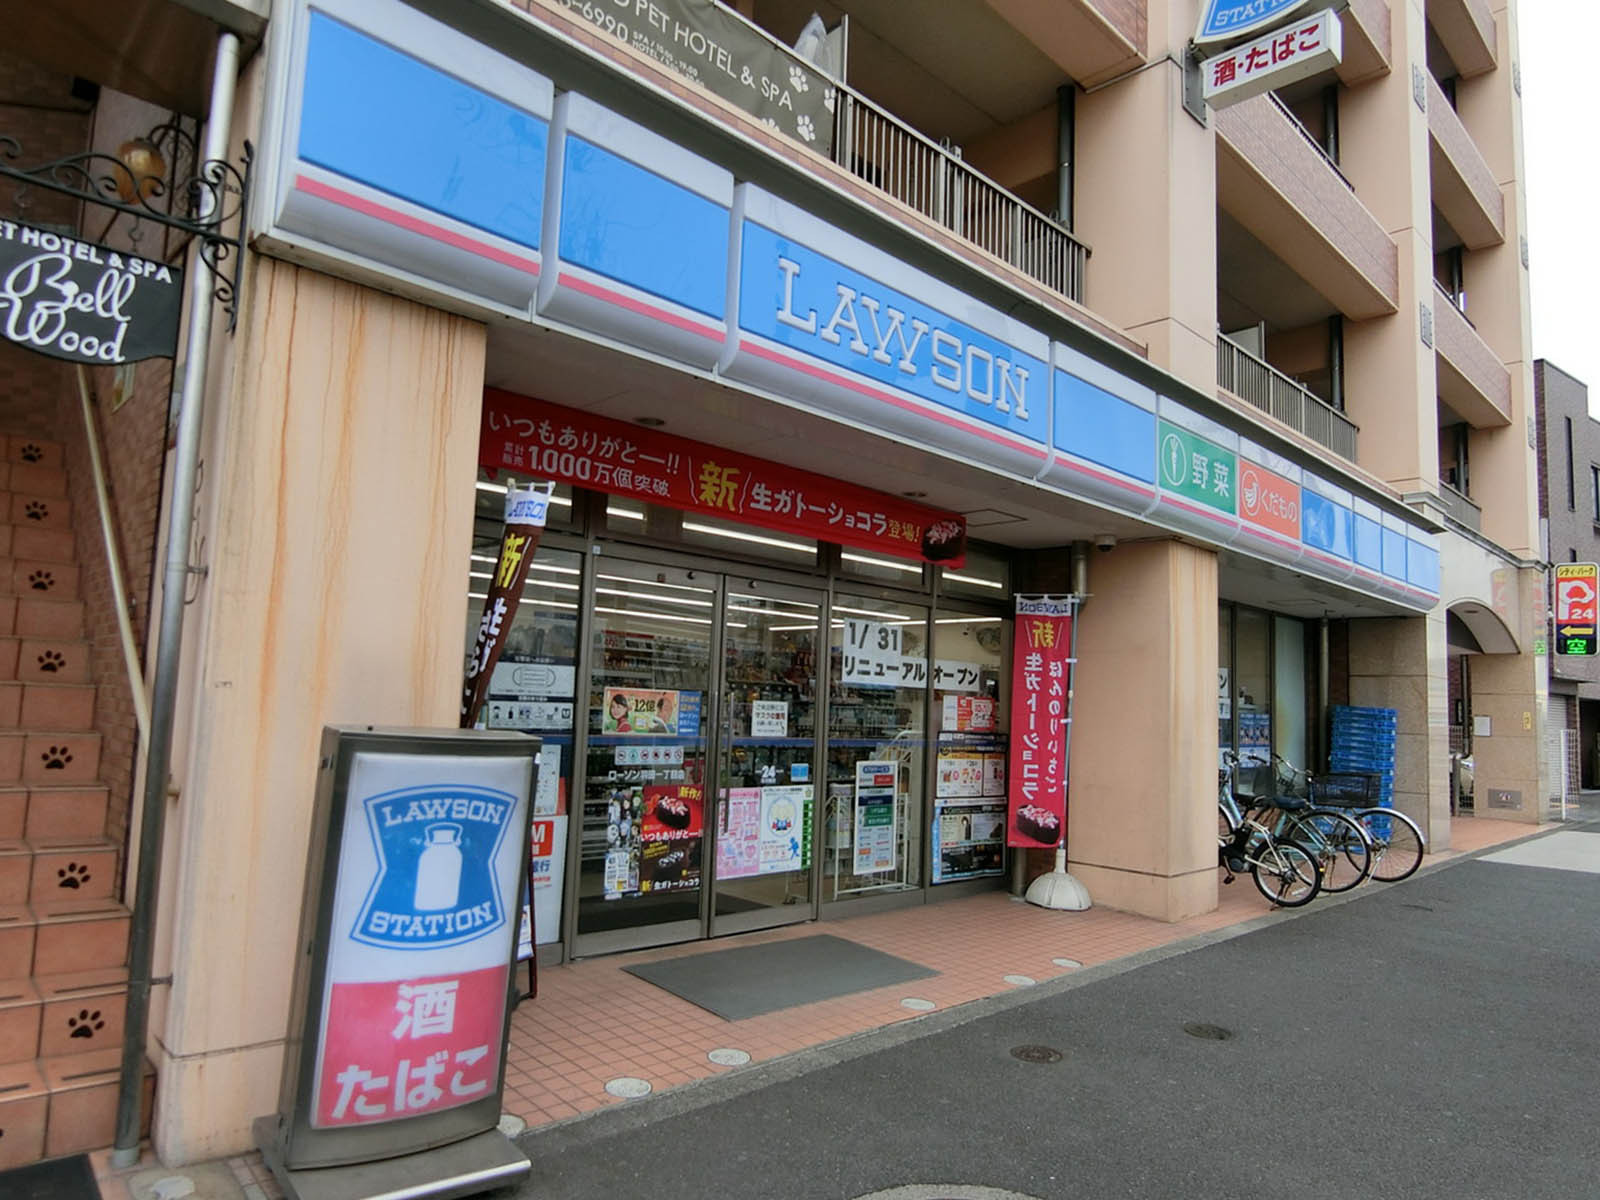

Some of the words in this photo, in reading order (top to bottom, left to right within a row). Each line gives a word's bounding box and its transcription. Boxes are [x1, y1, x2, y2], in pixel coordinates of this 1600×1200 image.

[635, 0, 669, 33] PET
[674, 21, 737, 79] HOTEL
[740, 65, 755, 89] &
[760, 76, 793, 111] SPA
[1213, 24, 1320, 87] 酒・たばこ
[21, 226, 104, 265] HOTEL
[108, 252, 125, 270] &
[129, 258, 172, 284] SPA
[5, 252, 136, 322] Bell
[0, 292, 128, 362] Wood
[776, 256, 1029, 421] LAWSON
[699, 460, 741, 512] 新
[1191, 452, 1230, 498] 野菜
[1260, 490, 1298, 523] くだもの
[1571, 608, 1594, 620] 24
[1567, 638, 1587, 655] 空
[382, 798, 504, 827] LAWSON
[366, 901, 494, 939] STATION
[392, 980, 459, 1041] 酒
[331, 1045, 488, 1120] たばこ
